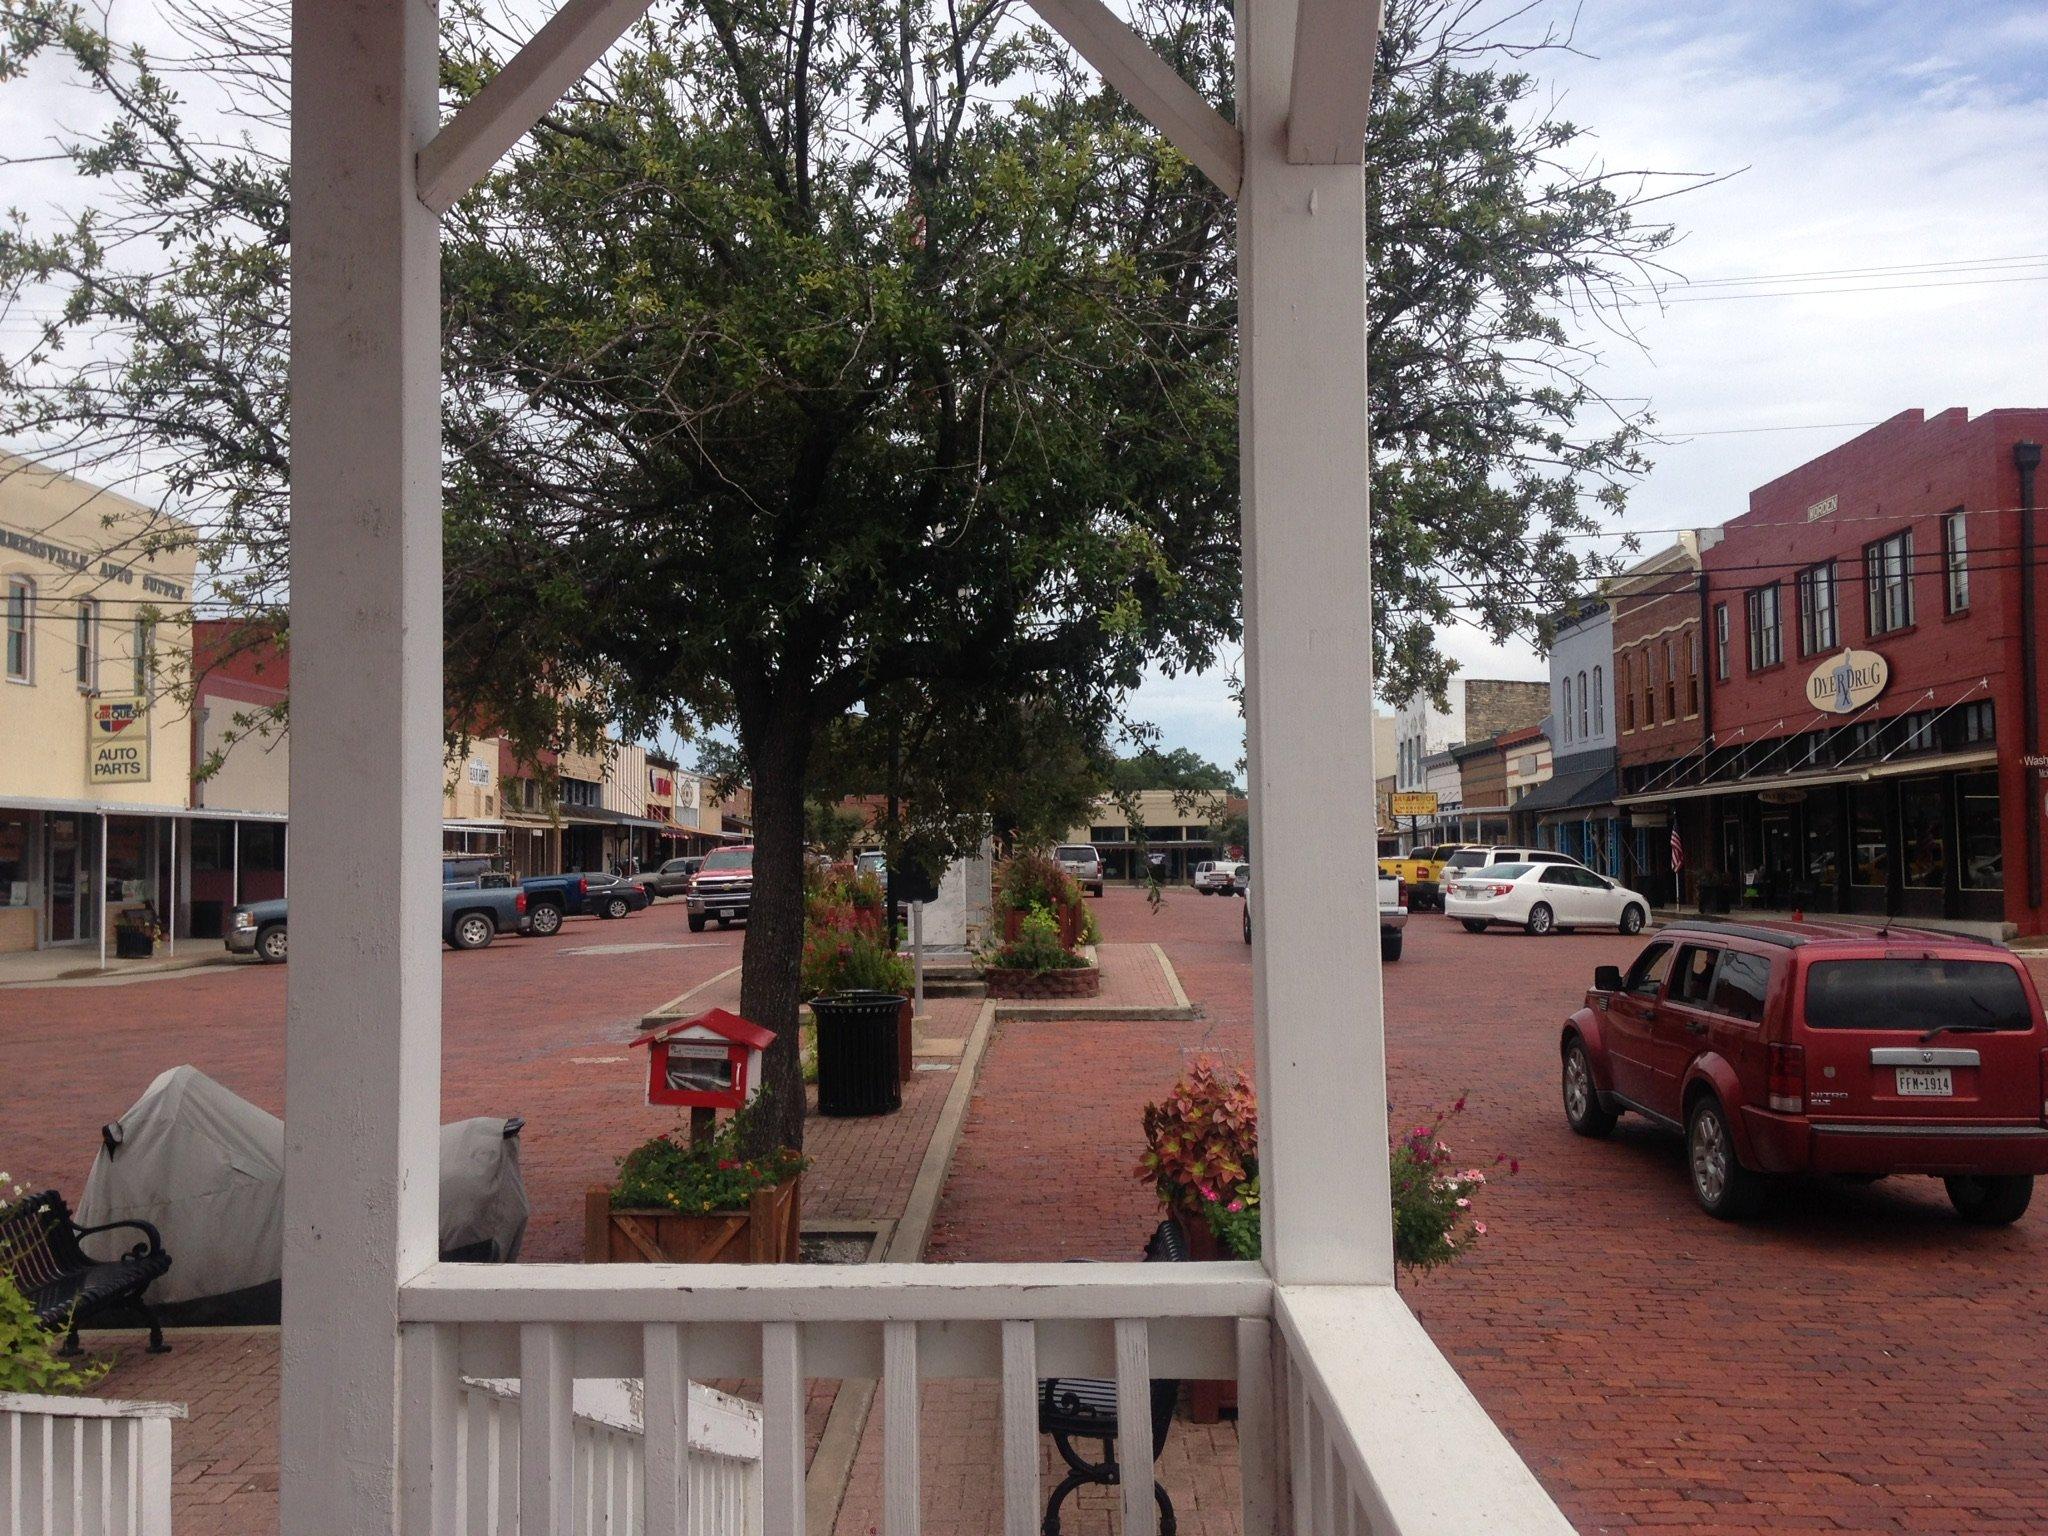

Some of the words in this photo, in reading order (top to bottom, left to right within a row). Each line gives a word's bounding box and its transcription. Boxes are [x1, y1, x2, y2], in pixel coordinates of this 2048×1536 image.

[1813, 673, 1847, 700] DYER
[1846, 661, 1880, 689] DRUG
[99, 747, 138, 761] AUTO
[95, 761, 141, 776] PARTS
[1810, 1091, 1849, 1099] NITRO
